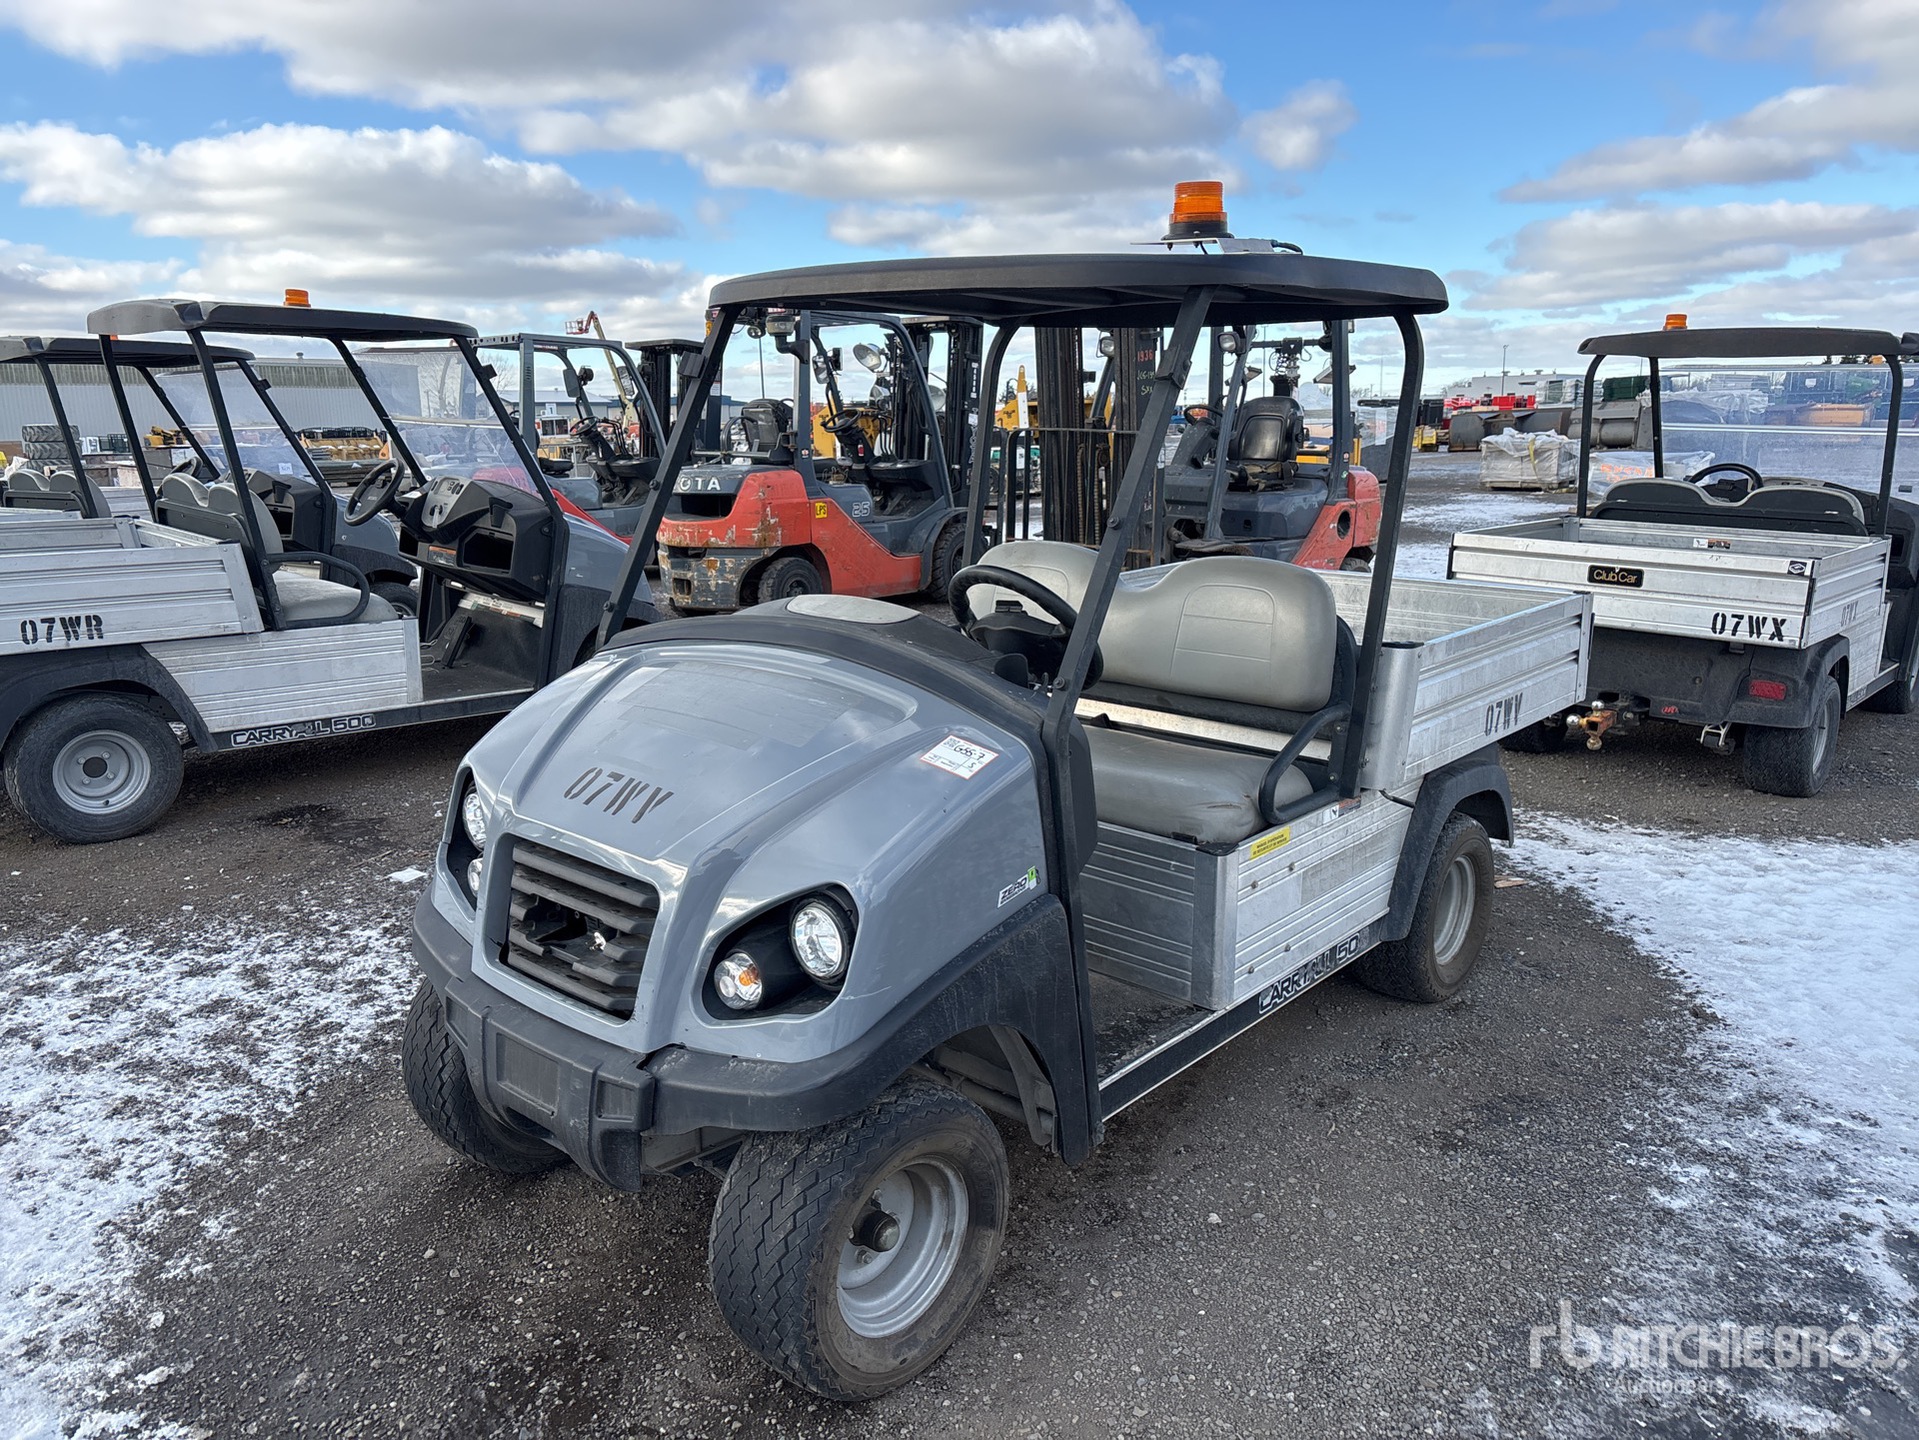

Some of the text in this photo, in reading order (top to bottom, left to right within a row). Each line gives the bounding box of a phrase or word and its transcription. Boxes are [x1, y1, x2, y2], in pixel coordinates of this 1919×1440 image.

[851, 501, 871, 518] 25
[1593, 569, 1638, 583] Club Car
[20, 615, 104, 645] 07WR
[1711, 612, 1787, 642] 07WX
[332, 714, 376, 732] 500
[563, 767, 675, 824] 07WY
[1001, 877, 1028, 900] ZERO
